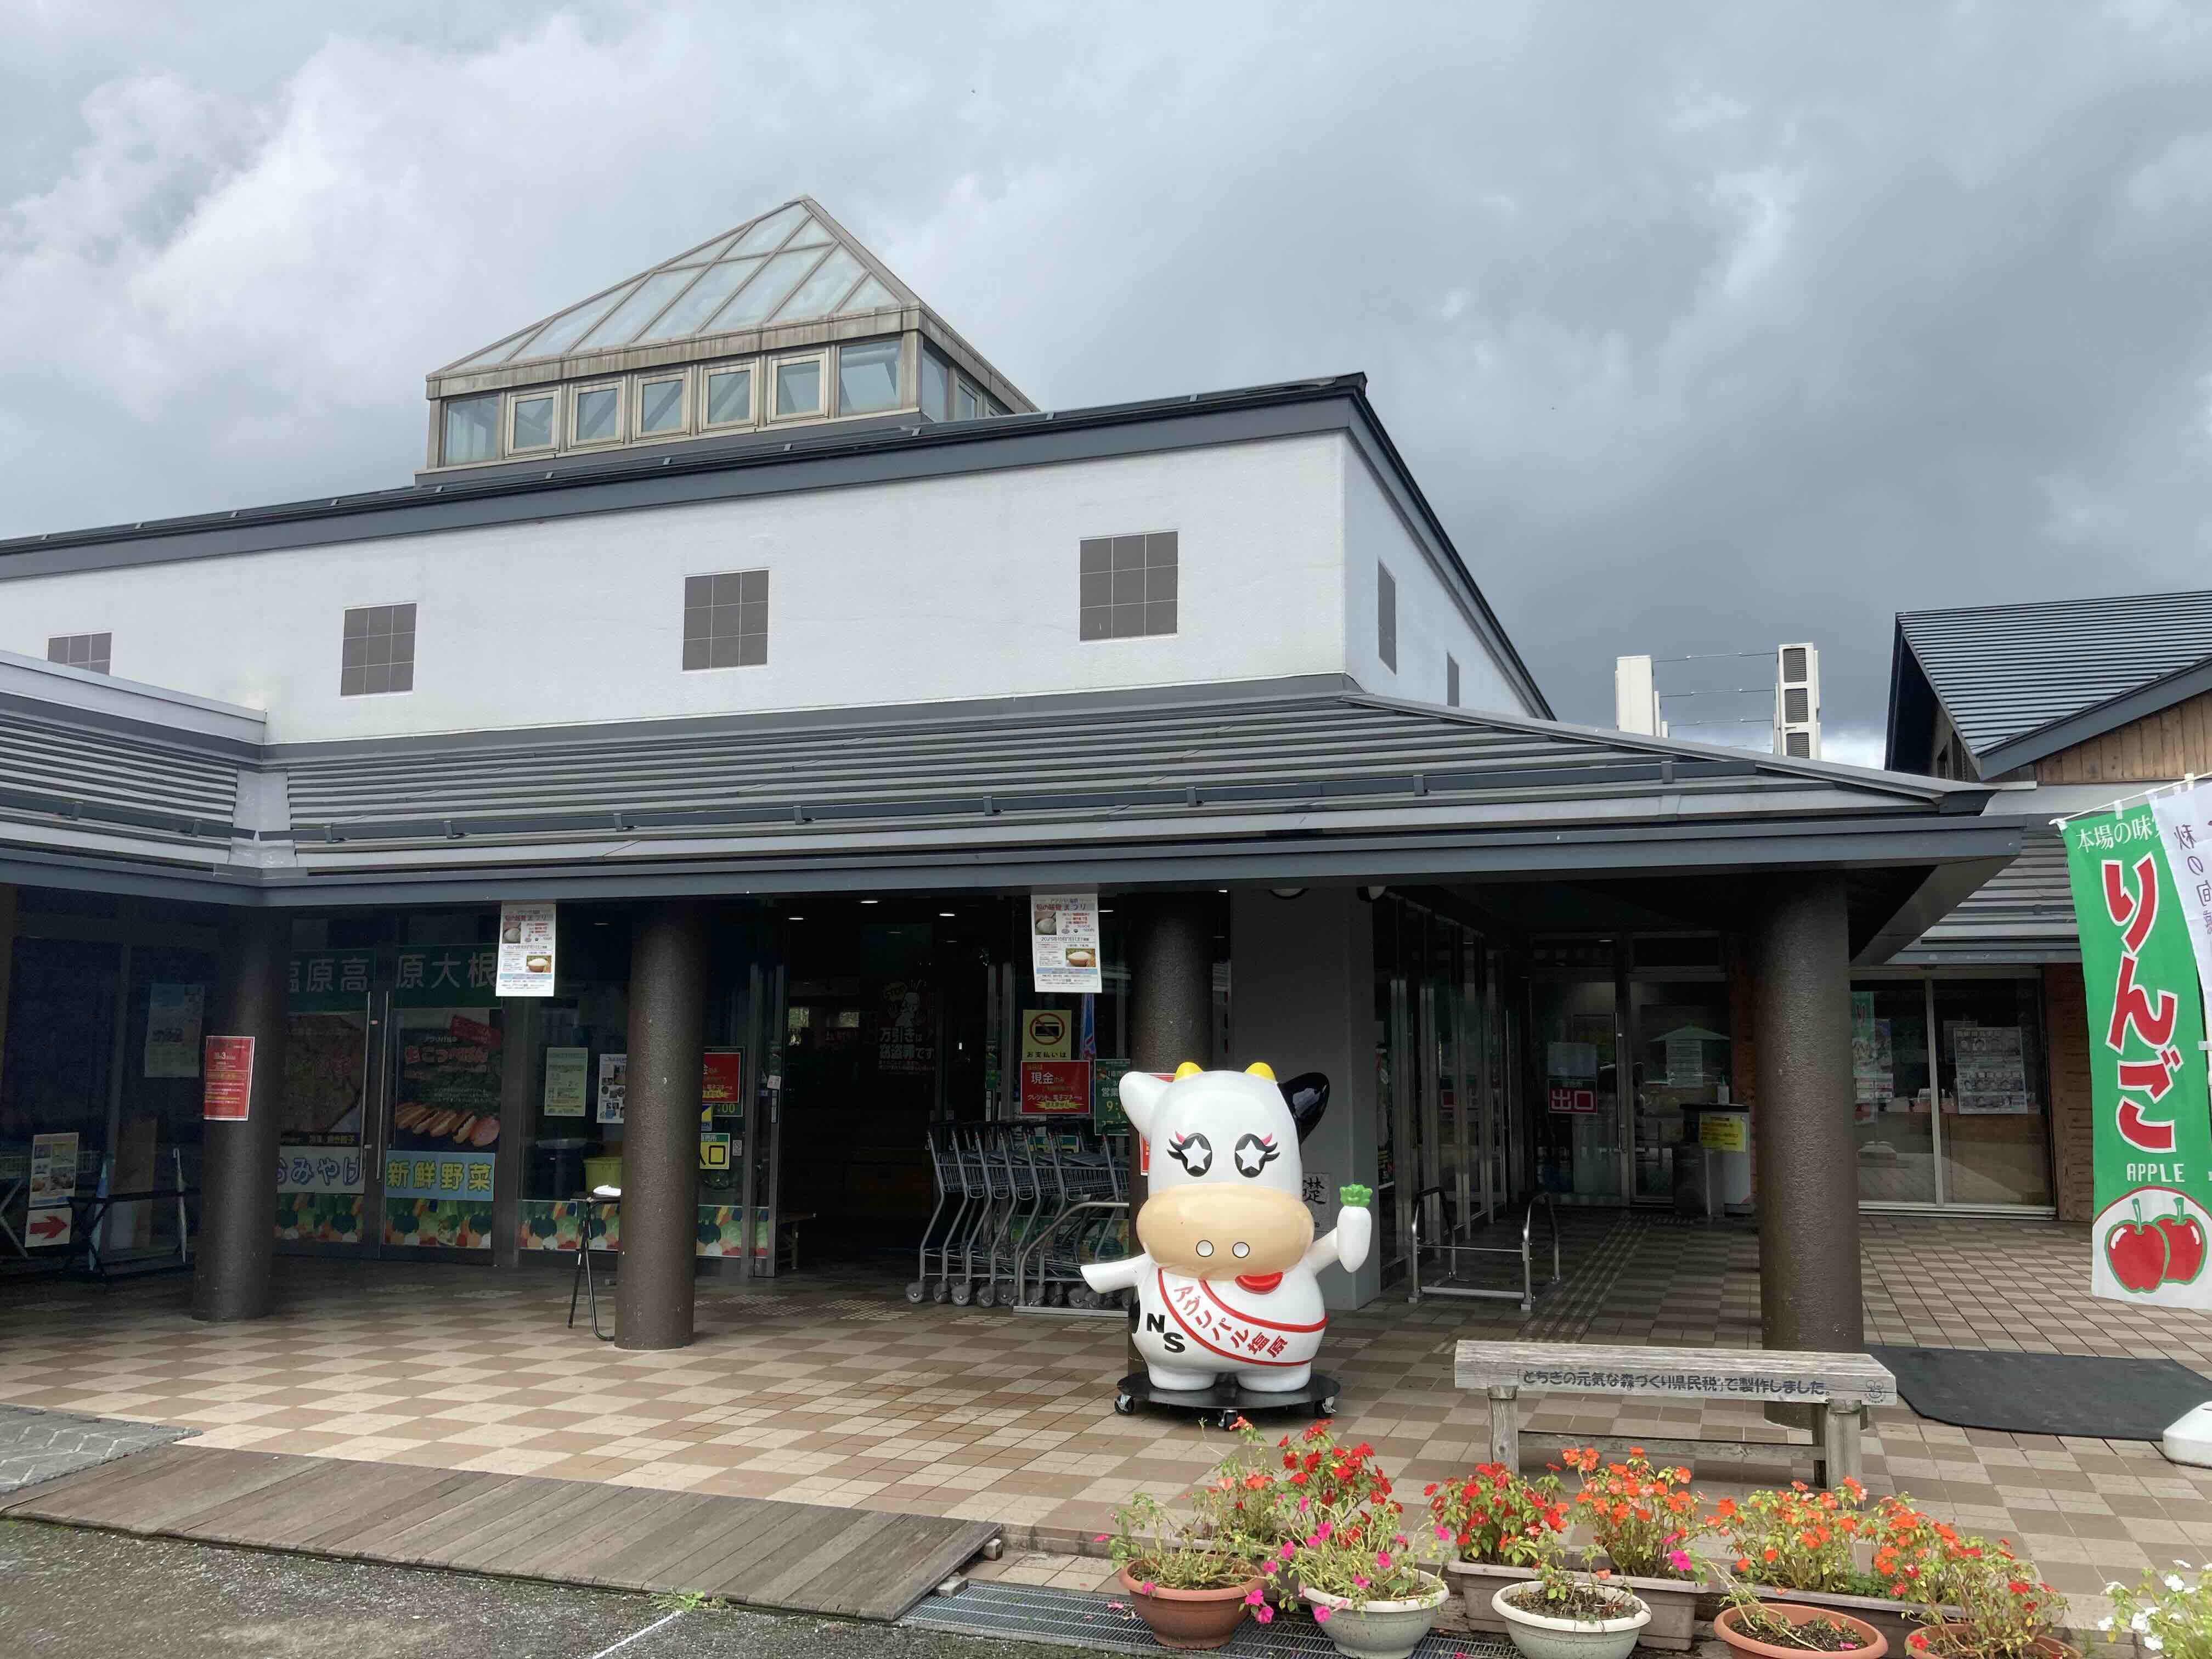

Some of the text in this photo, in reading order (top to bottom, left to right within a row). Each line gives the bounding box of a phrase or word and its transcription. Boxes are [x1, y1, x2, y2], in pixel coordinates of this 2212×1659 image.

[2101, 851, 2183, 1153] りんご
[1551, 1089, 1594, 1110] 出口
[387, 1159, 492, 1191] 新鮮野菜
[2127, 1163, 2185, 1182] APPLE
[1174, 1284, 1288, 1358] アグリパル塩原
